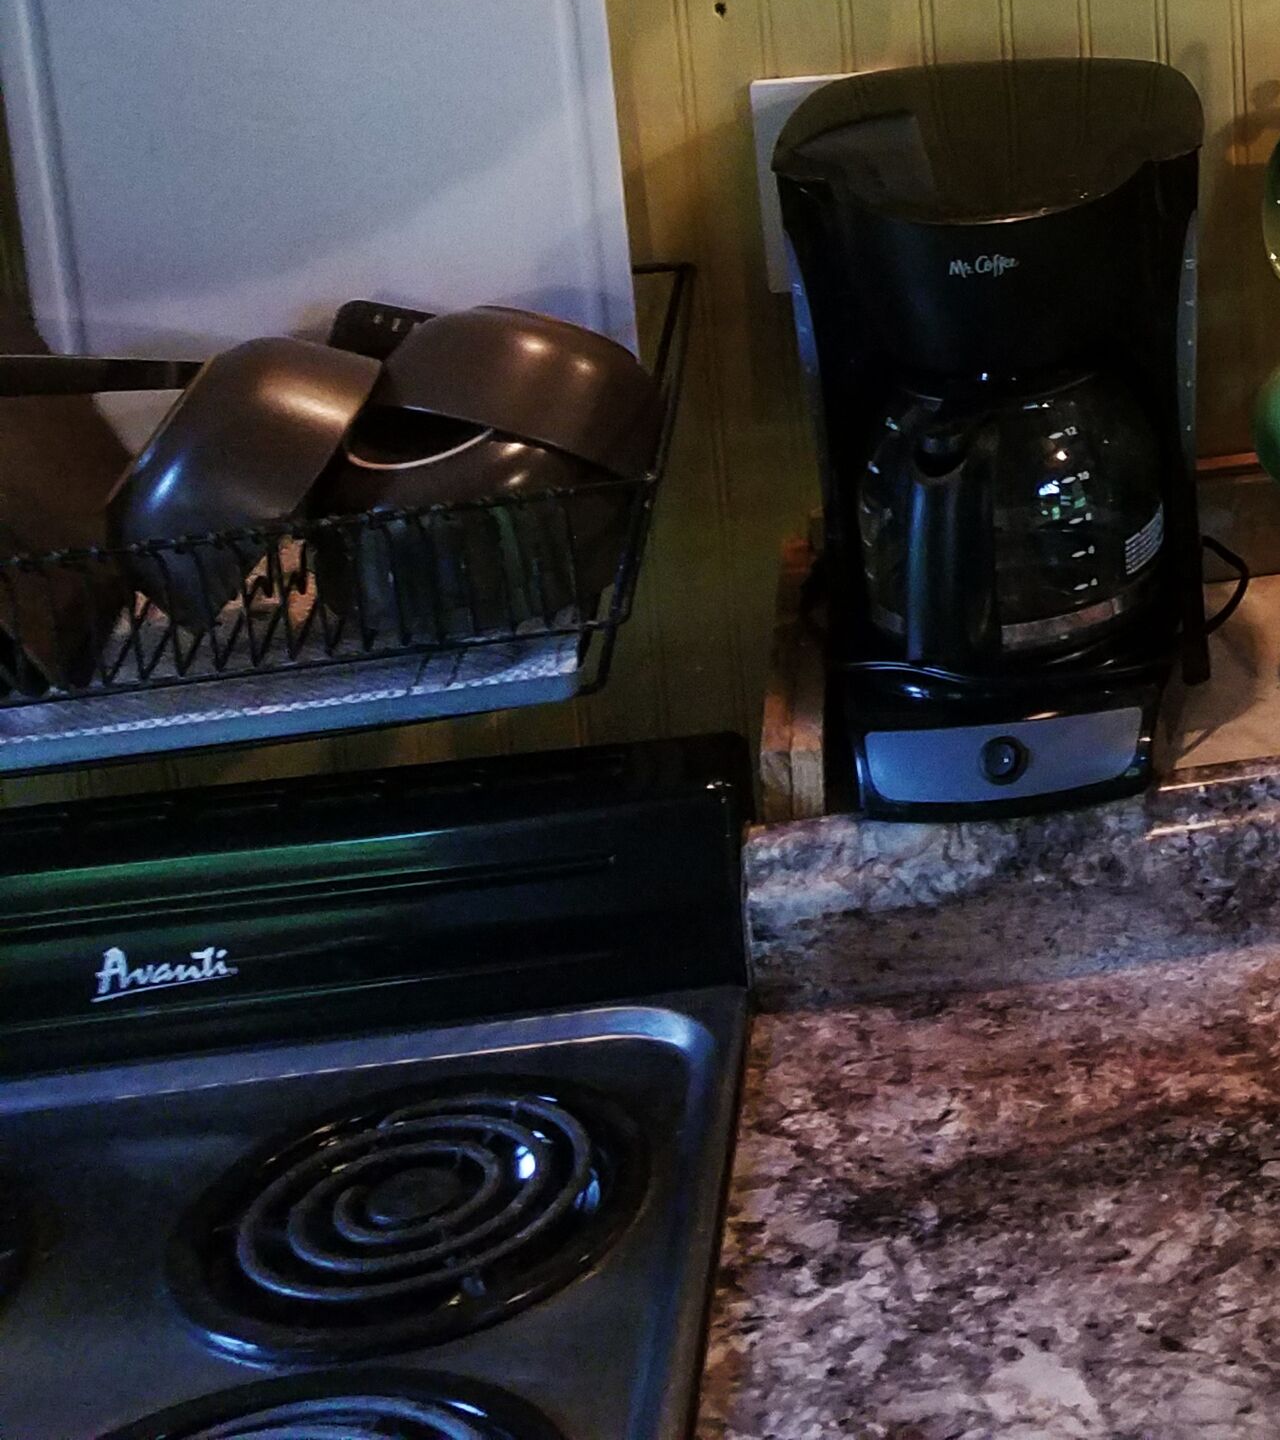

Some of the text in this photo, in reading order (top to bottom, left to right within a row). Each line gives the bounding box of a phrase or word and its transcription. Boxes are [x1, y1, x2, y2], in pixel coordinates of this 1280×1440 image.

[974, 254, 1018, 278] Coffee
[1064, 426, 1078, 437] 12
[95, 946, 229, 994] Avanti
